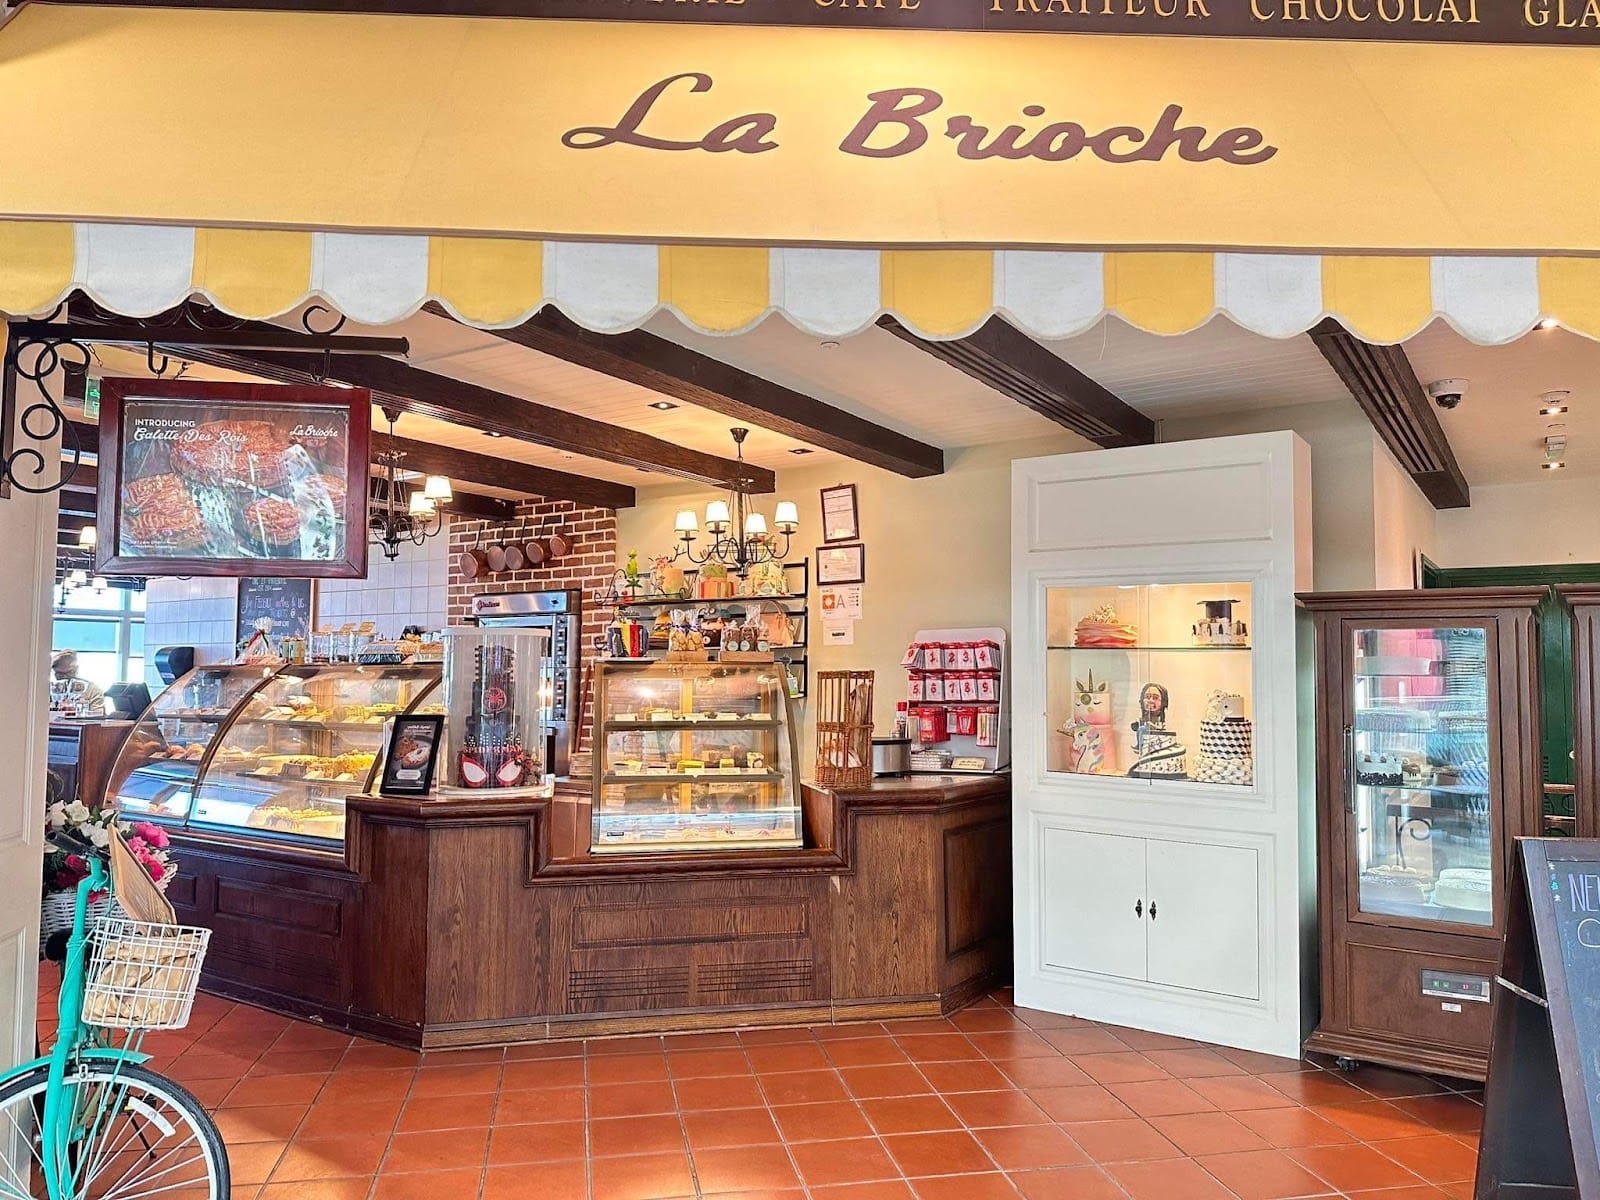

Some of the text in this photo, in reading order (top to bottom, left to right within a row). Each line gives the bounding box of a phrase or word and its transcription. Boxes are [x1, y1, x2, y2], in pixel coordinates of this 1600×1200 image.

[561, 72, 1279, 164] La Brioche
[134, 418, 196, 428] INTRODUCING
[183, 428, 212, 442] Des
[289, 424, 339, 437] La Brioche
[836, 594, 846, 609] A
[1568, 873, 1600, 912] NE
